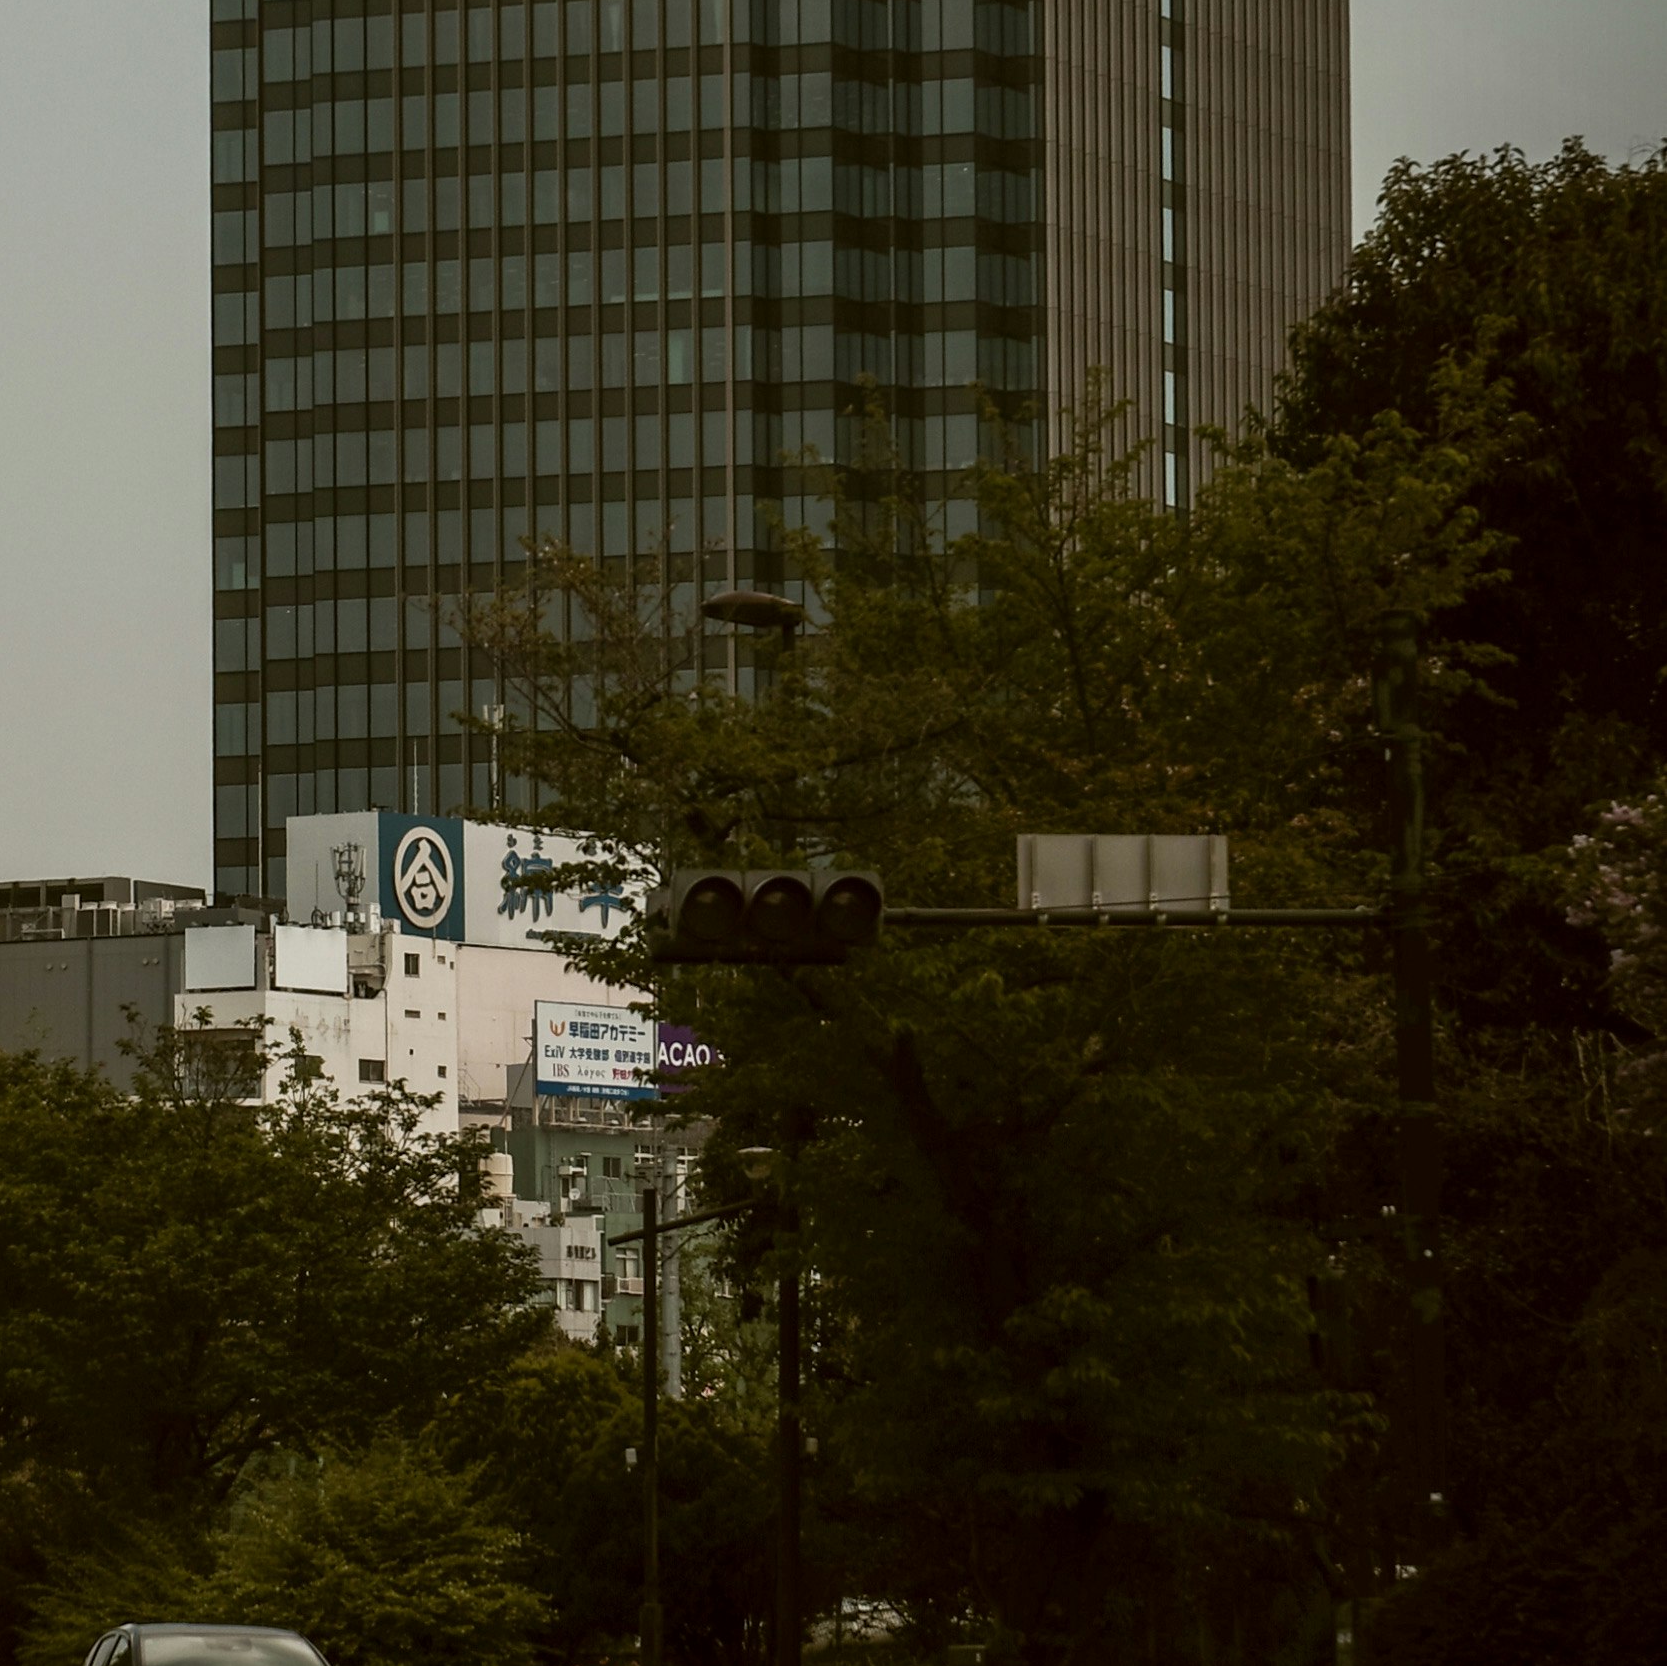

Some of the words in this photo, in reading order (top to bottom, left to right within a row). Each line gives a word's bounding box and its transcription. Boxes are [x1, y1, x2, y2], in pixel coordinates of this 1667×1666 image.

[569, 1021, 646, 1043] 早稲田アカデミー
[552, 1063, 570, 1078] IBS
